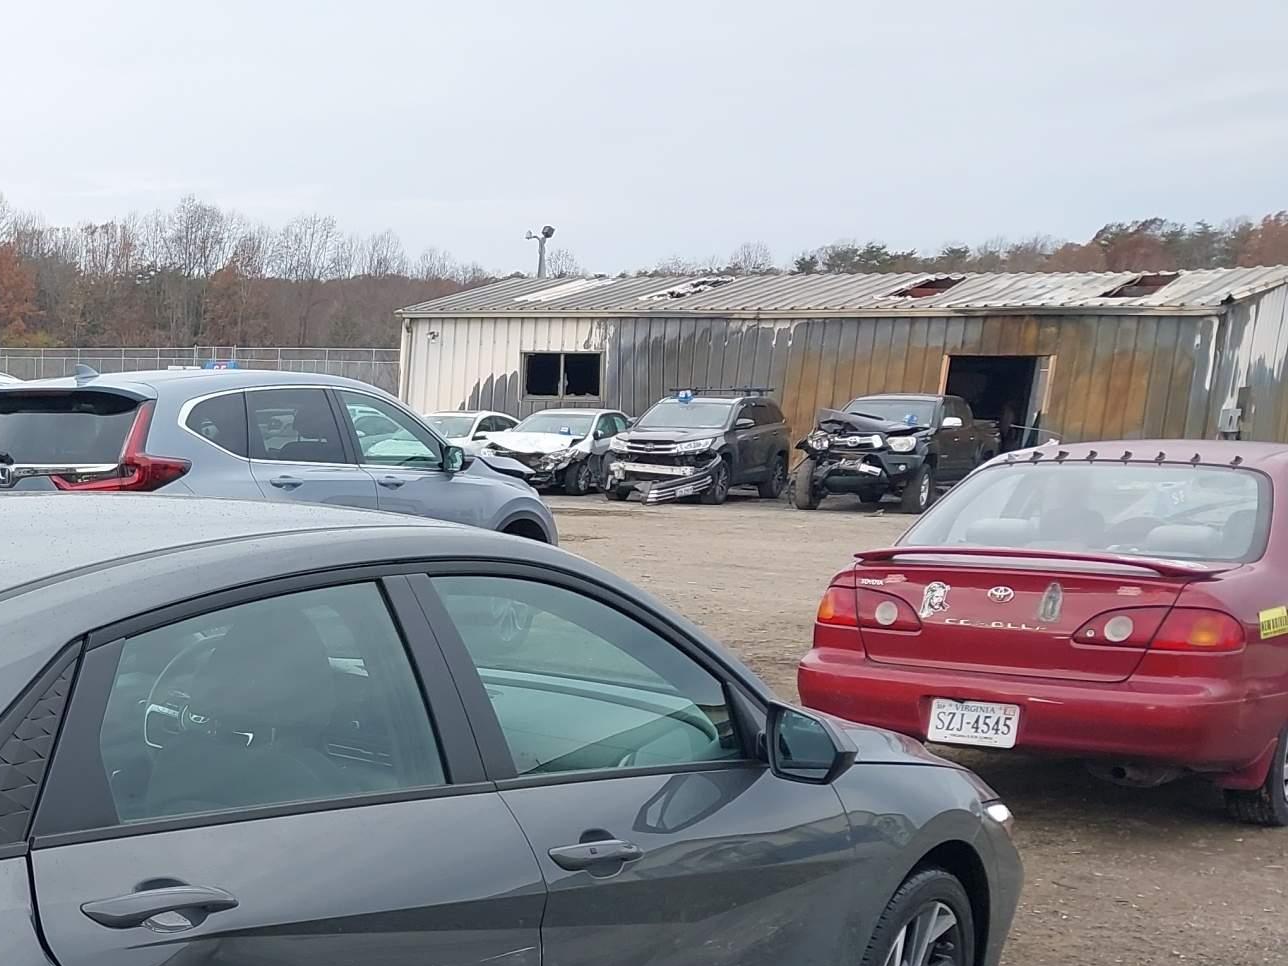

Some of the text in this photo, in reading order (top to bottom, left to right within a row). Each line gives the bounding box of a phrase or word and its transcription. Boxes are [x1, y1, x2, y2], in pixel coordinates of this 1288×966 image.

[860, 577, 884, 586] TOYOTA
[954, 703, 996, 714] VIRGINIA
[935, 711, 1013, 736] SZJ-4545
